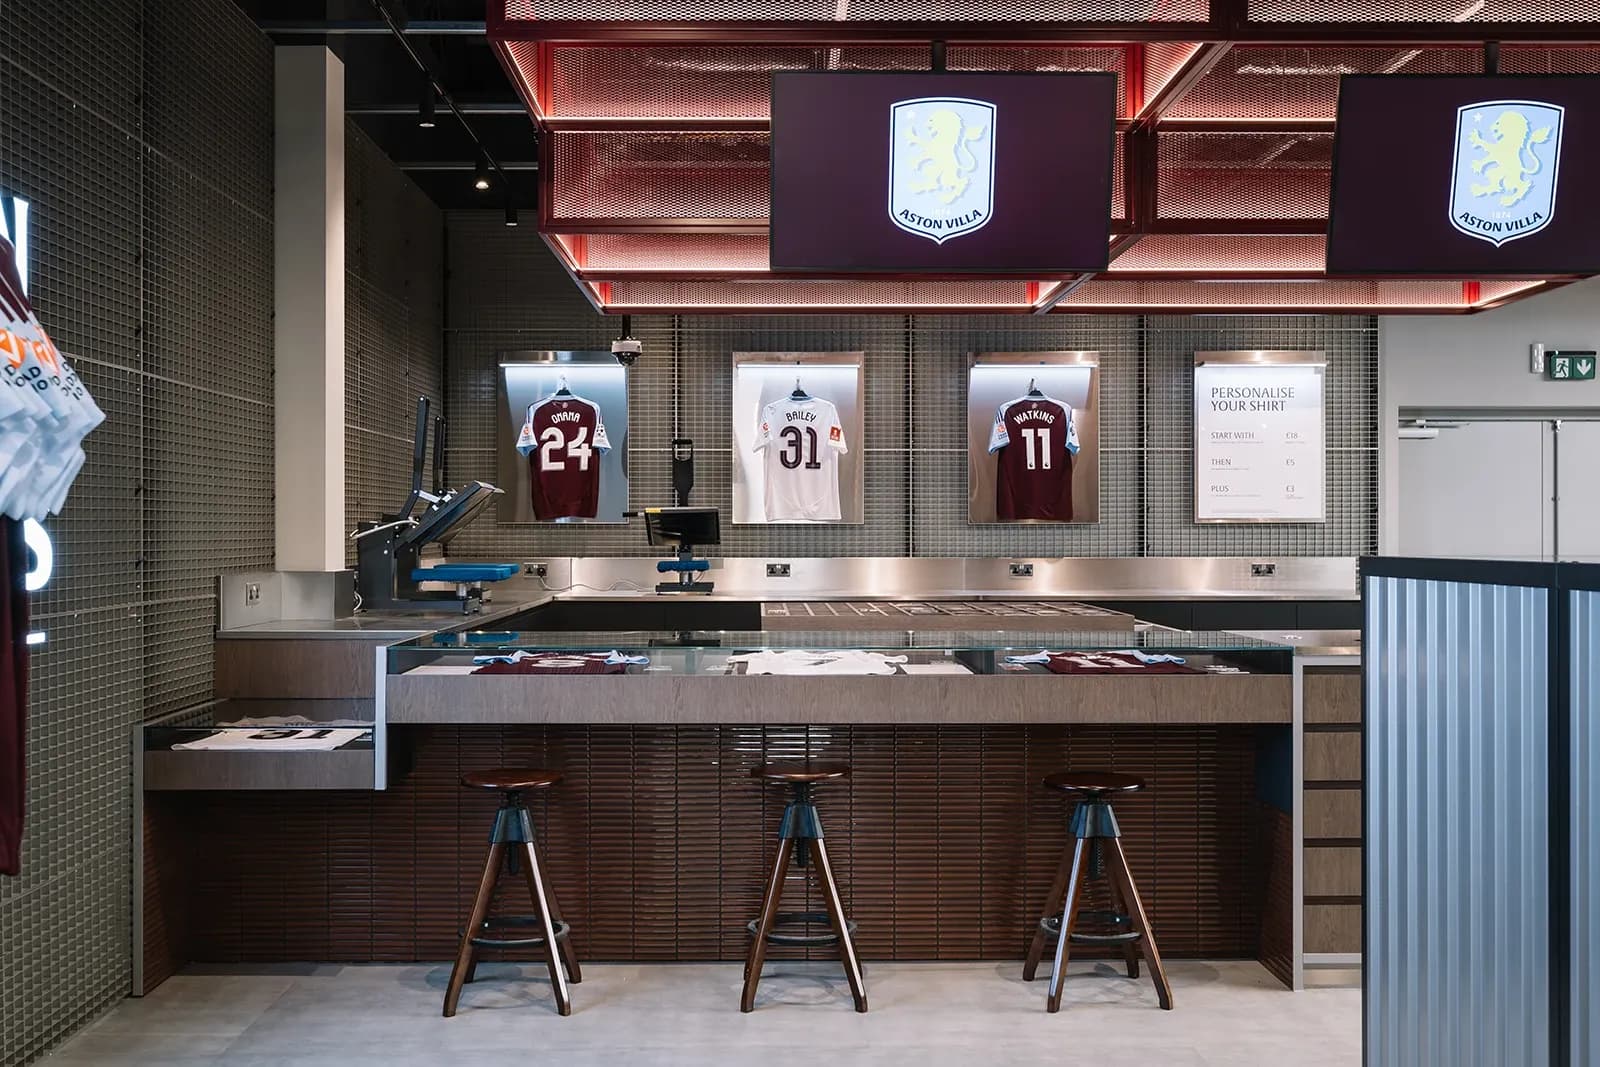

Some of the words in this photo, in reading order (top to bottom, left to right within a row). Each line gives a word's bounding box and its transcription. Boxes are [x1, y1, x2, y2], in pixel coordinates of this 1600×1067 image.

[899, 208, 943, 229] ASTON
[945, 208, 983, 229] VILLA
[1459, 211, 1502, 232] ASTON
[1505, 211, 1543, 232] VILLA
[1211, 387, 1295, 398] PERSONALISE
[1211, 400, 1249, 411] YOUR
[1250, 400, 1286, 411] SHIRT
[785, 410, 817, 422] BAILEY
[1013, 409, 1055, 425] WATKINS
[1211, 431, 1232, 440] START
[1233, 431, 1255, 440] WITH
[539, 426, 592, 471] 24
[779, 425, 821, 470] 31
[1021, 428, 1051, 470] 11
[1211, 458, 1231, 466] THEN
[1211, 485, 1229, 493] PLUS
